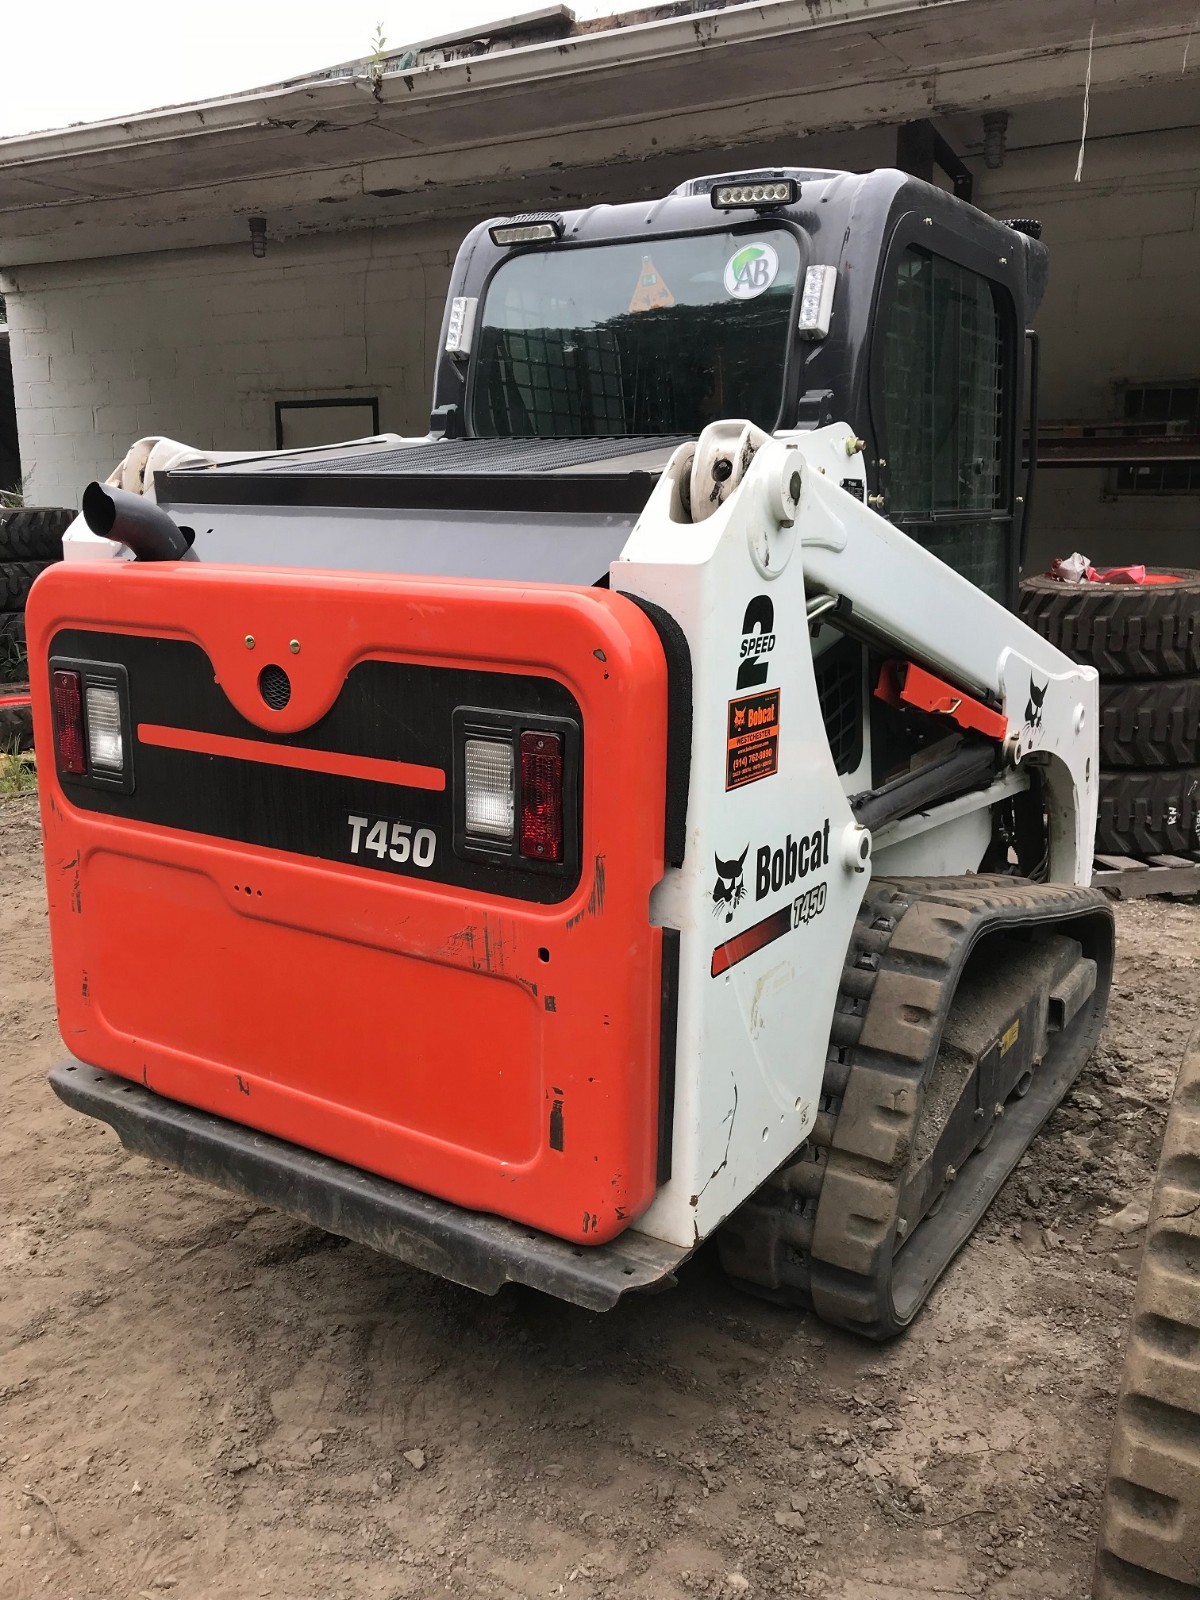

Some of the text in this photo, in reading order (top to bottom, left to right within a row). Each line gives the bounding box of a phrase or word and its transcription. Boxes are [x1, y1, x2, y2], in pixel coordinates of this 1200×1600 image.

[732, 259, 770, 291] AB
[740, 634, 776, 658] SPEED
[747, 703, 775, 727] Bobcat
[736, 729, 771, 746] WESTCHESTER
[348, 815, 437, 868] T450
[756, 818, 830, 902] Bobcat
[793, 881, 828, 929] T450
